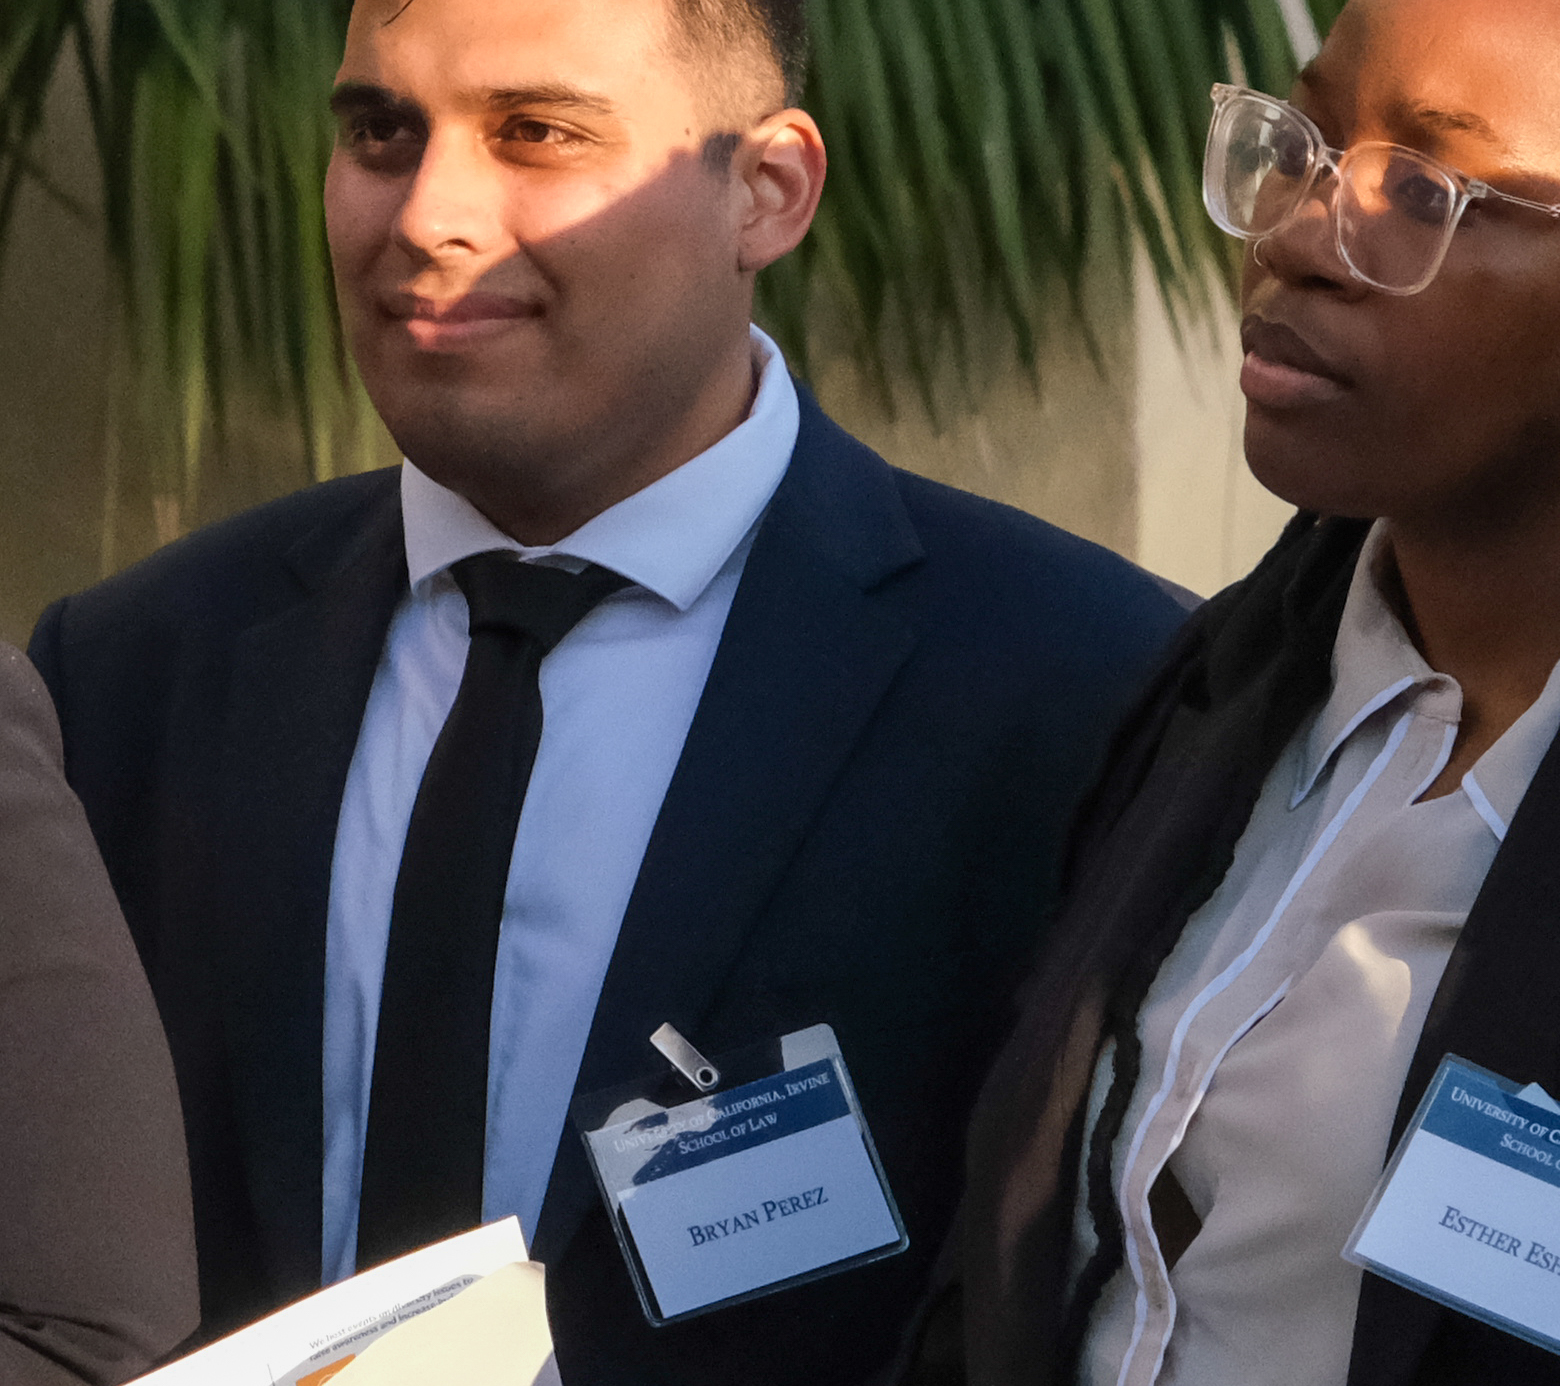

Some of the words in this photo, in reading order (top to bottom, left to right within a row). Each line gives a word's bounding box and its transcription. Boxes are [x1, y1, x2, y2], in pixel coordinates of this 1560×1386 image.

[614, 1120, 686, 1154] UNIVERSITY
[689, 1115, 705, 1128] OF
[707, 1091, 786, 1123] CALIFORNIA,
[785, 1072, 830, 1097] IRVINE
[679, 1132, 730, 1155] SCHOOL
[730, 1124, 747, 1138] OF
[748, 1112, 778, 1132] LAW
[1451, 1086, 1530, 1131] UNIVERSITY
[1529, 1122, 1549, 1137] OF
[1500, 1134, 1554, 1167] SCHOOL
[688, 1209, 760, 1246] BRYAN
[762, 1186, 829, 1222] PEREZ
[1438, 1206, 1522, 1259] ESTHER
[381, 1316, 397, 1329] and
